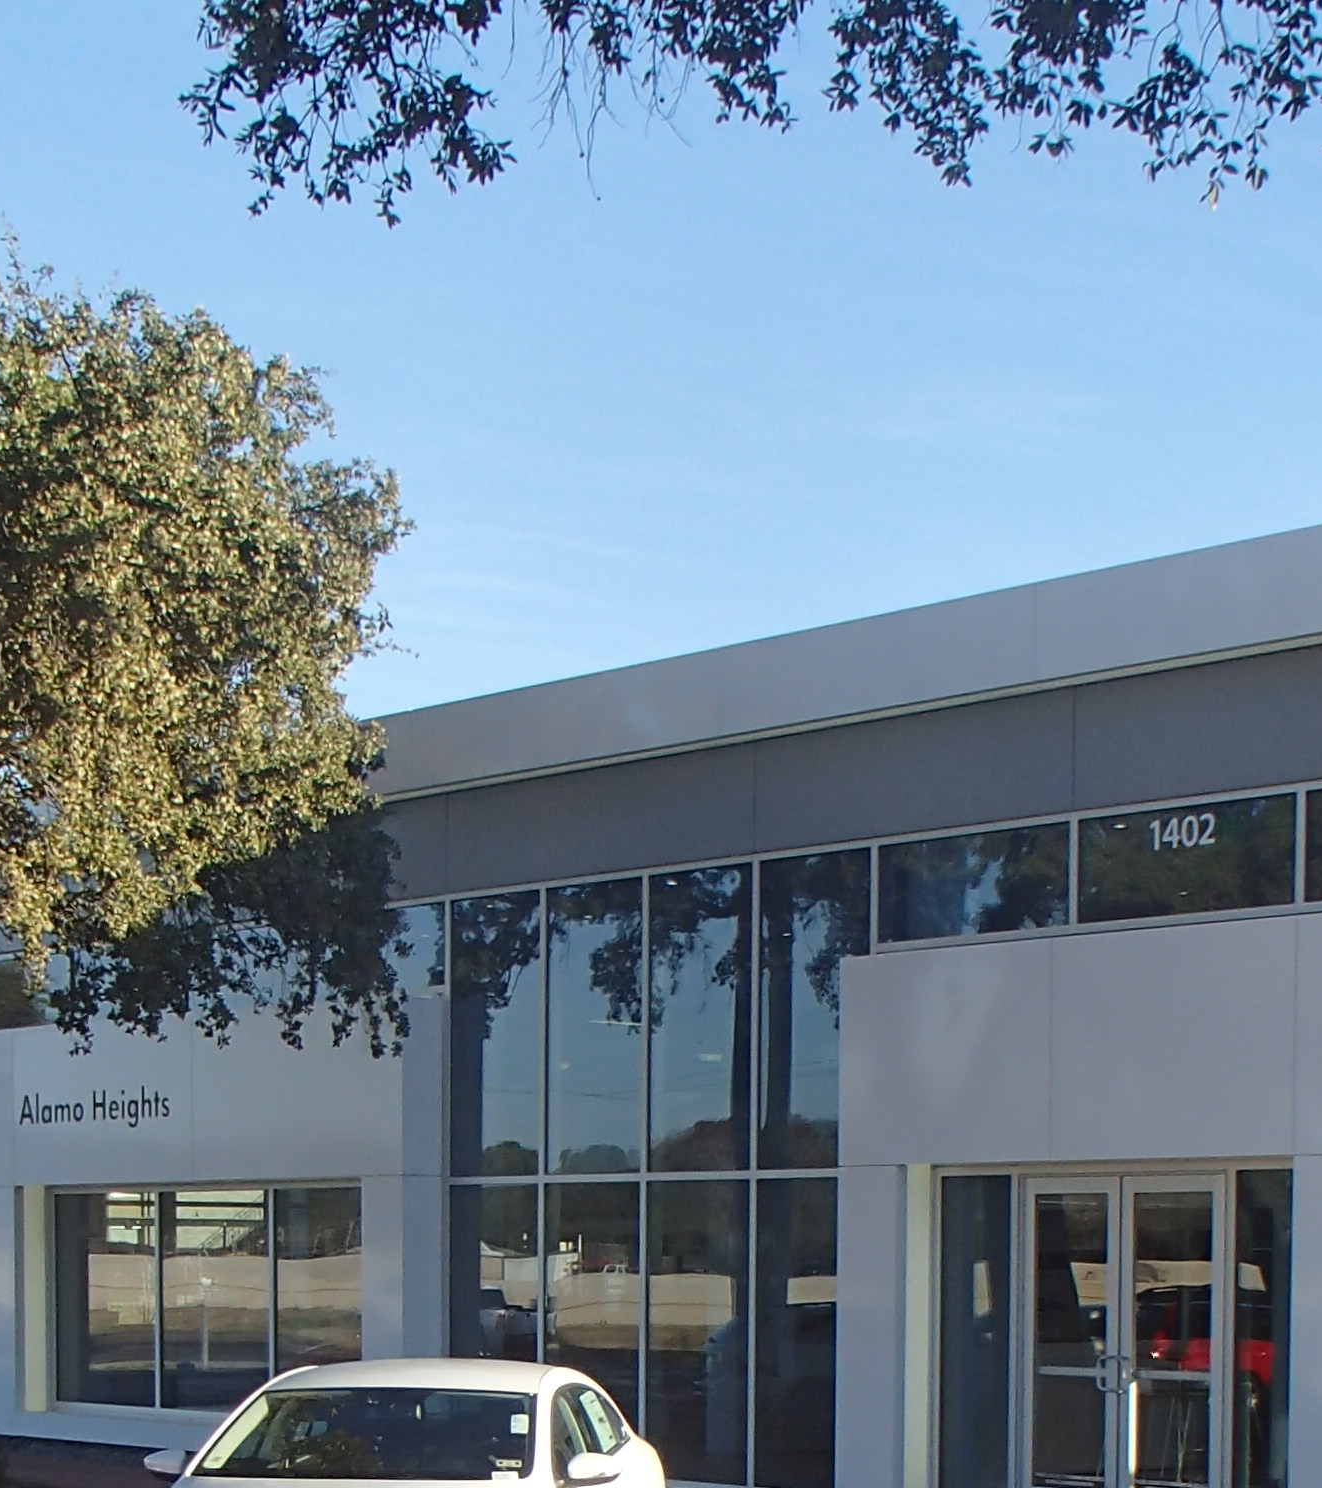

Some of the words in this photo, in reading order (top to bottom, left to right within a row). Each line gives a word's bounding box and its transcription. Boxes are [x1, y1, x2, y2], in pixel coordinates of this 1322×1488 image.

[1149, 812, 1217, 851] 1402
[19, 1092, 84, 1125] Alamo
[92, 1085, 170, 1128] Heights
